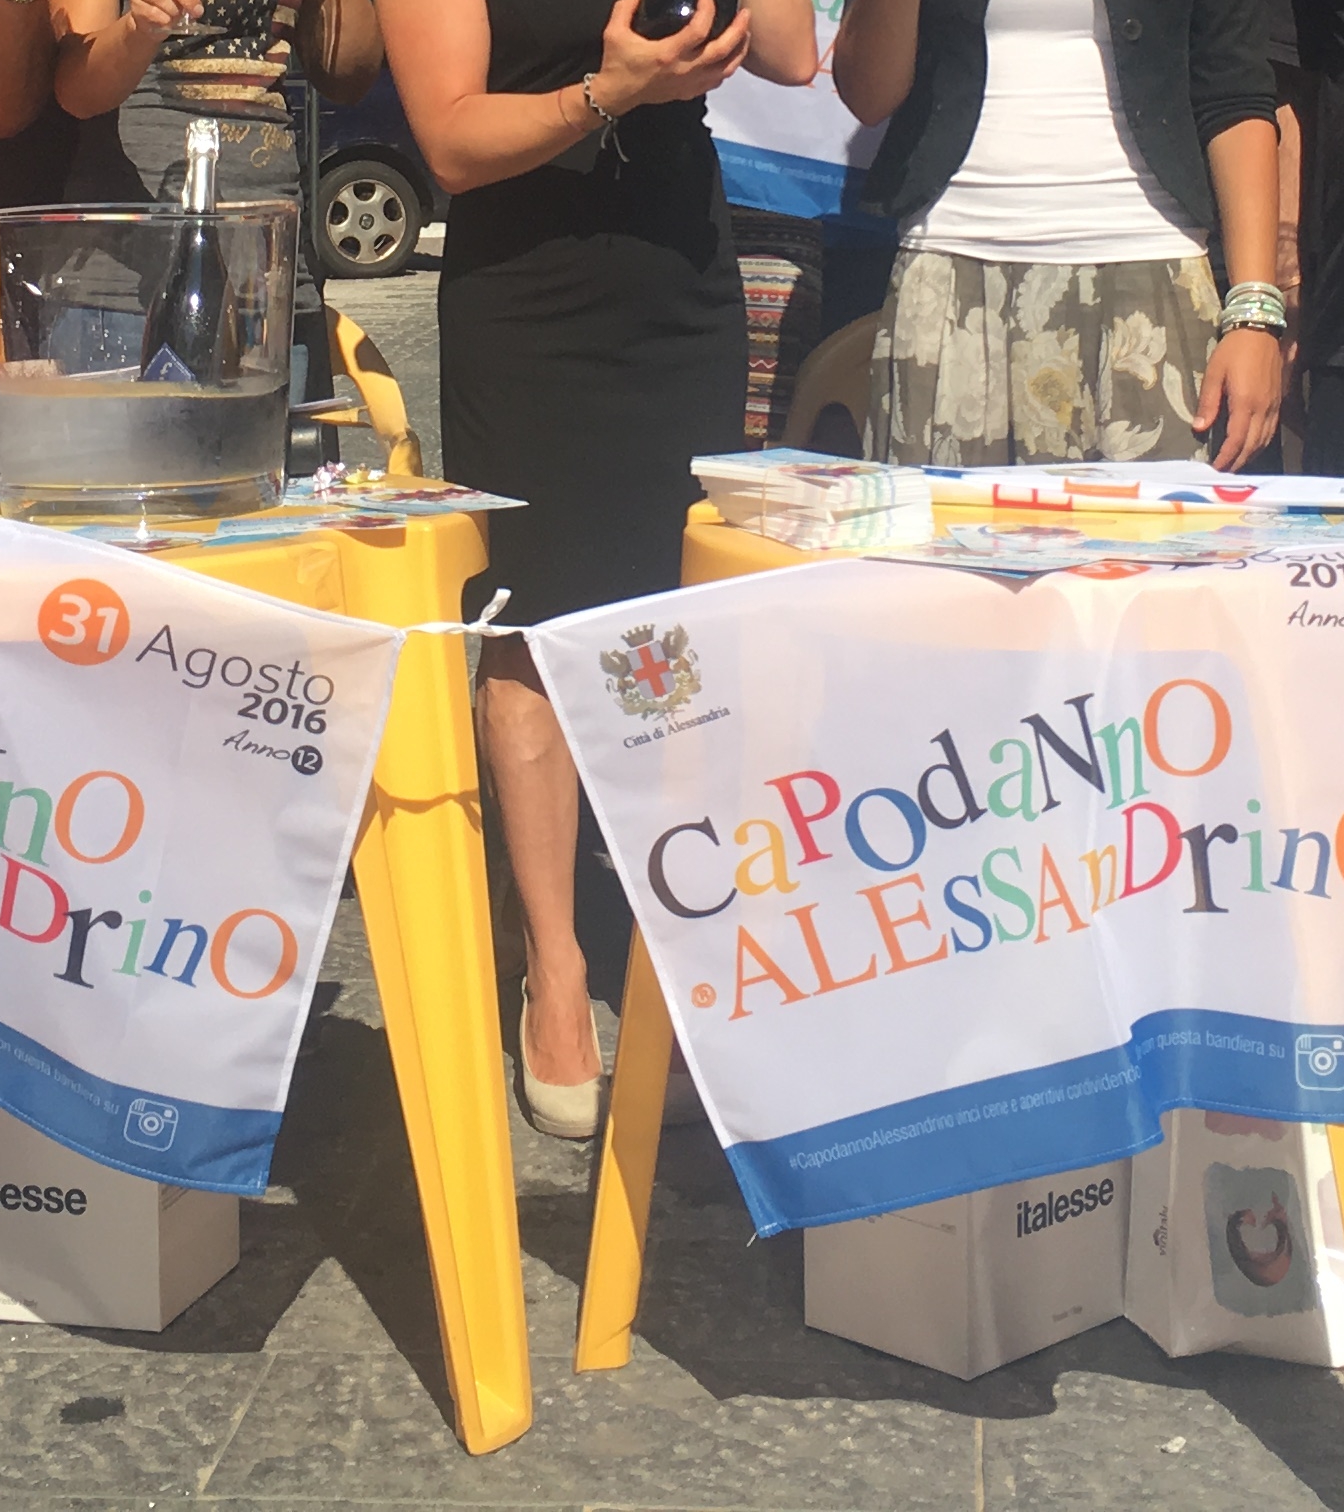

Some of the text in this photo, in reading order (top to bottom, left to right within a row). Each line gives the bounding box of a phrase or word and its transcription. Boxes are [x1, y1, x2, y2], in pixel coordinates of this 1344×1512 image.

[47, 594, 337, 708] 31 Agosto
[237, 691, 329, 737] 2016
[623, 705, 731, 749] Città di Alessandria
[297, 748, 320, 771] 12
[1156, 1029, 1202, 1051] questa
[1205, 1029, 1266, 1056] bandiera
[1268, 1042, 1286, 1059] su
[13, 1048, 52, 1077] questa
[53, 1067, 102, 1107] bandiera
[102, 1098, 120, 1116] su
[788, 1112, 955, 1171] #CapodannoAlessandrino
[955, 1103, 981, 1127] vinci
[982, 1099, 1010, 1120] cene
[1010, 1097, 1018, 1113] e
[1015, 1175, 1115, 1240] italesse
